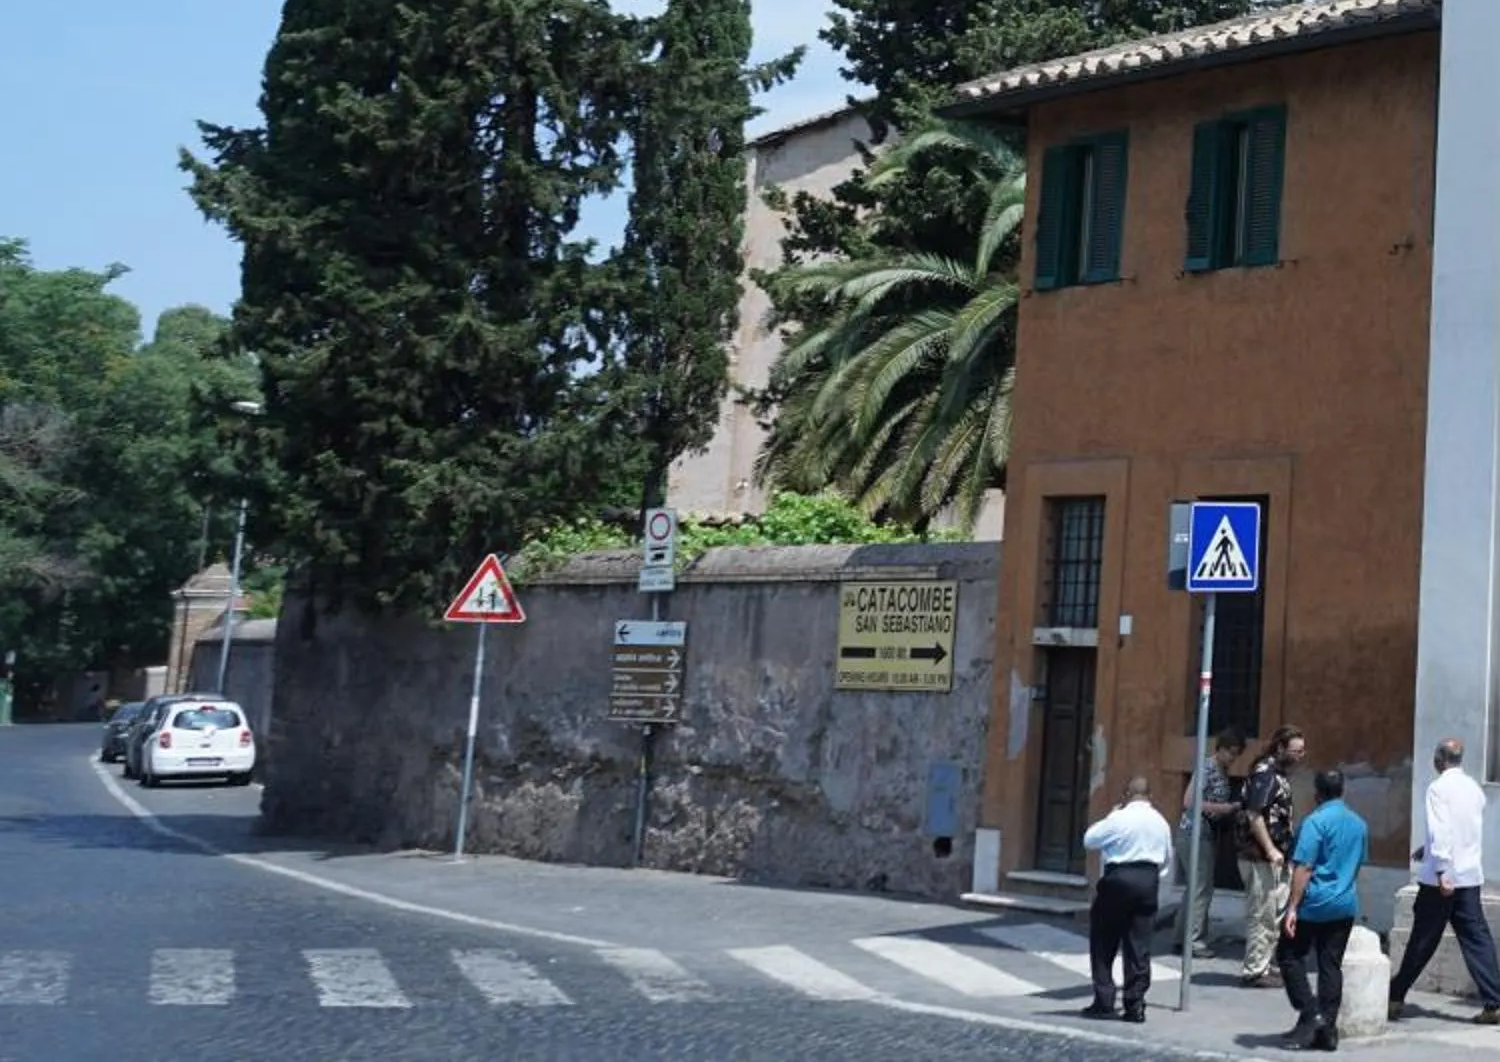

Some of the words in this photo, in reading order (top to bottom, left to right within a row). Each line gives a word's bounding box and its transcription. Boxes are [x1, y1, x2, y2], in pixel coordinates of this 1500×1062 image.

[857, 586, 953, 612] CATACOMBE
[855, 615, 877, 633] SAN
[882, 615, 952, 633] SEBASTIANO
